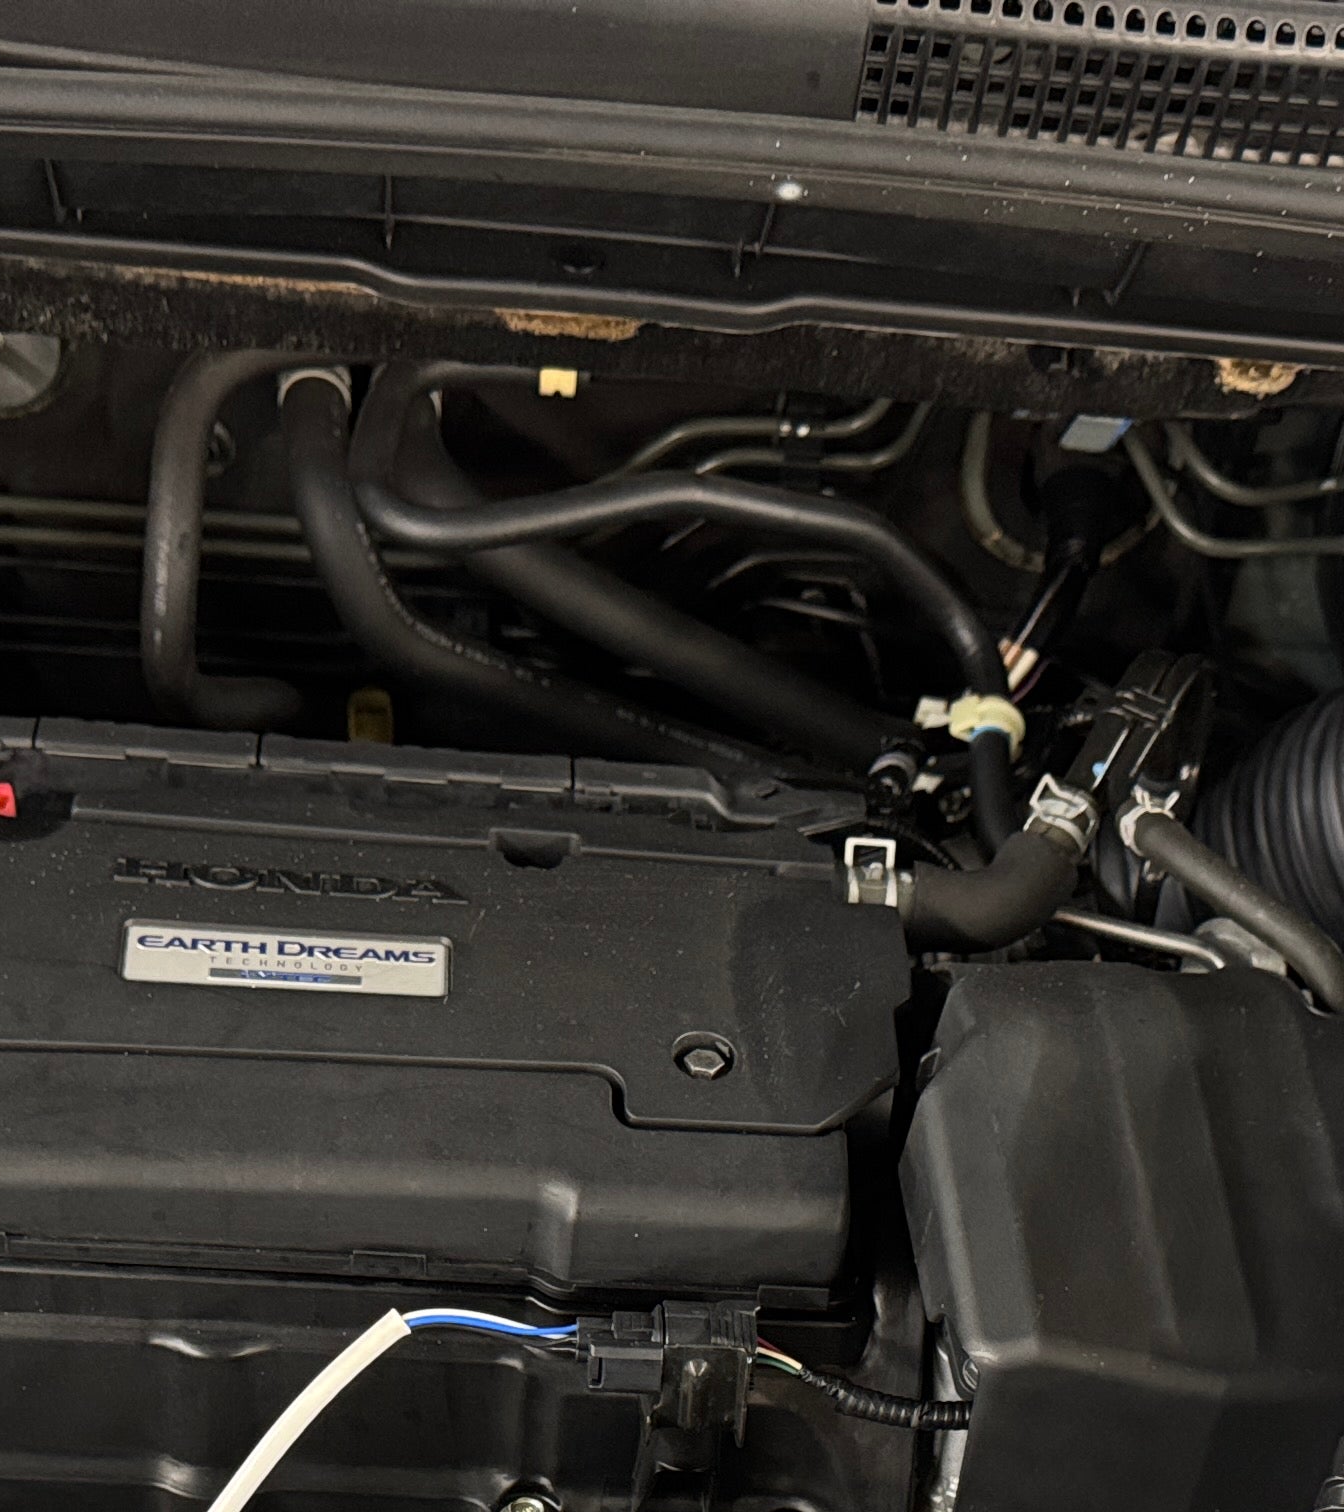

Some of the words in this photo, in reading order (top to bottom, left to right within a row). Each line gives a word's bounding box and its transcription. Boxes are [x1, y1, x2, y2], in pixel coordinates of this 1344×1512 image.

[114, 857, 469, 905] HONDA
[136, 934, 267, 956] EARTH
[276, 939, 437, 965] DREAMS
[209, 955, 365, 973] TECHNOLOGY
